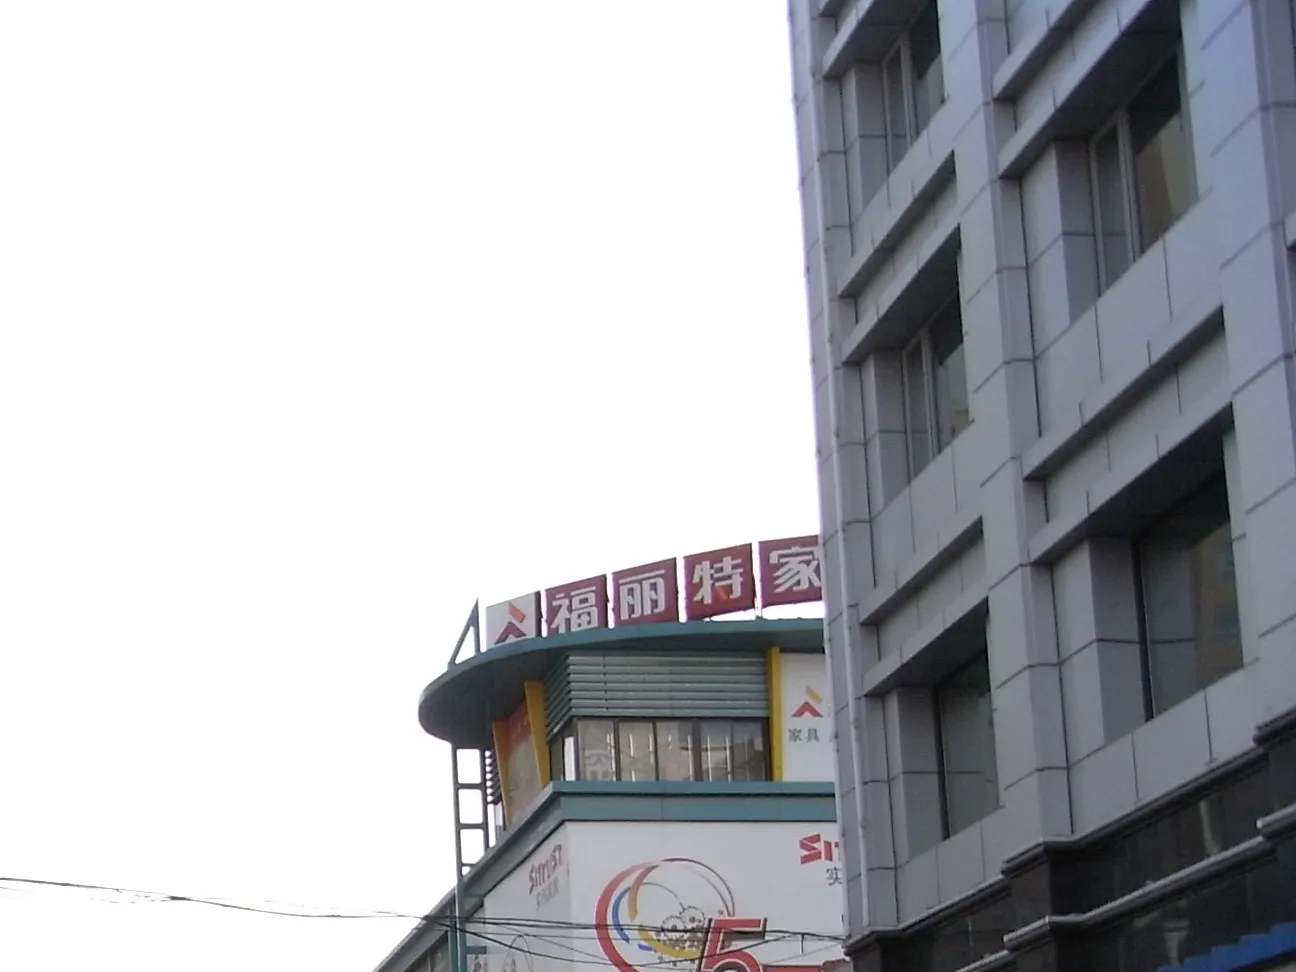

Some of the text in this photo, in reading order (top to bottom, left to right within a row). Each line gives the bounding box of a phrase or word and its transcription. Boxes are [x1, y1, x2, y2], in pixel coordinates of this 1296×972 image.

[552, 546, 822, 634] 福丽特家
[788, 728, 820, 743] 家具
